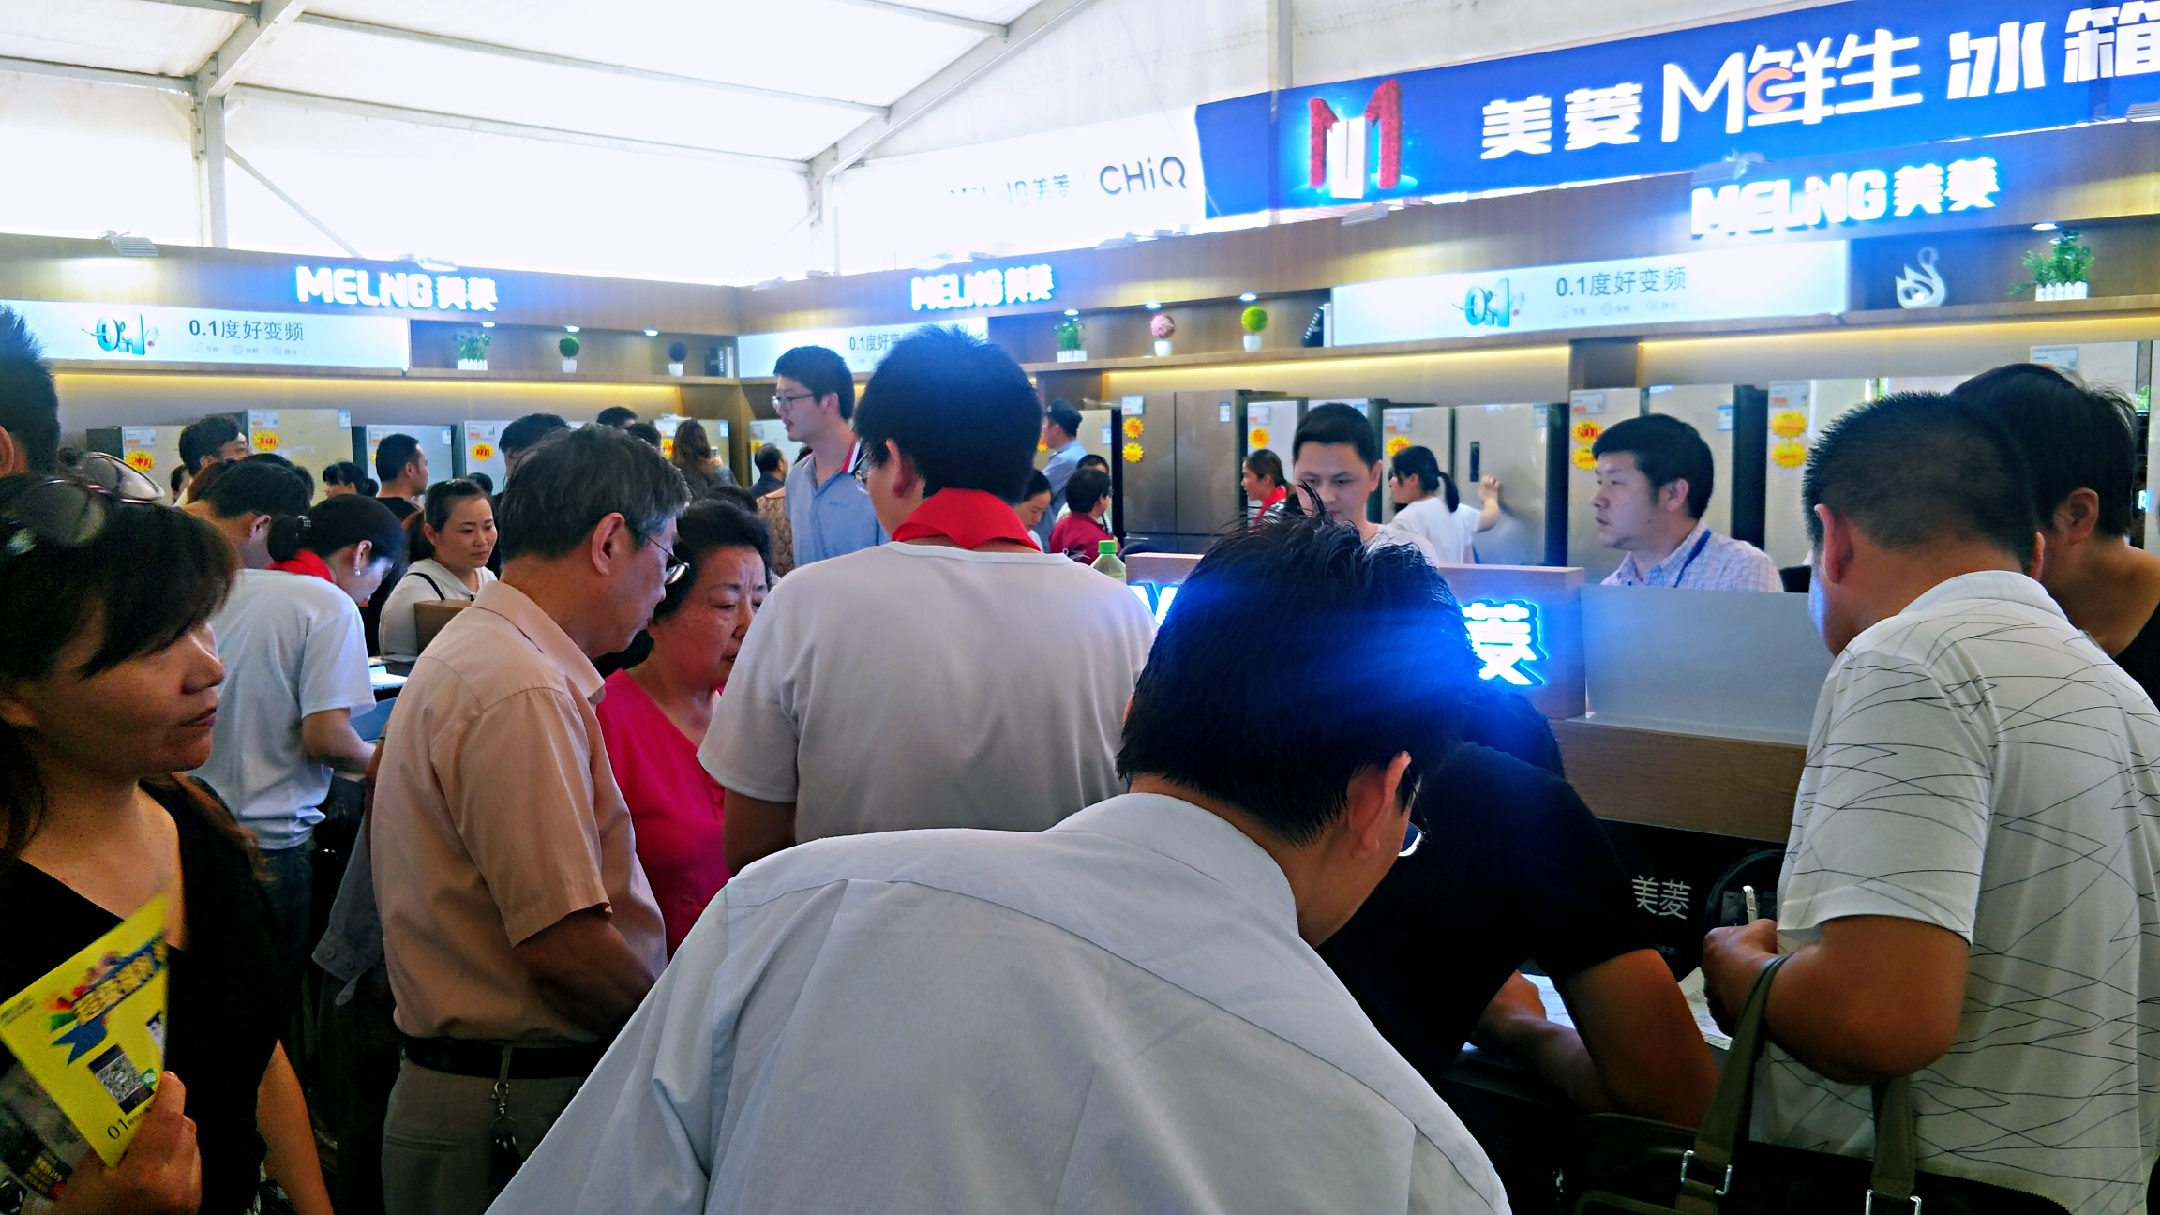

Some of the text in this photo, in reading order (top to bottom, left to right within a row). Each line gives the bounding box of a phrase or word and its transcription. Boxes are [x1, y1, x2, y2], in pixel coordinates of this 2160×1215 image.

[1100, 156, 1187, 195] CHiQ
[1556, 266, 1687, 297] 0.1度好变频
[188, 319, 304, 341] 0.1度好变频
[1631, 875, 1692, 920] 美菱
